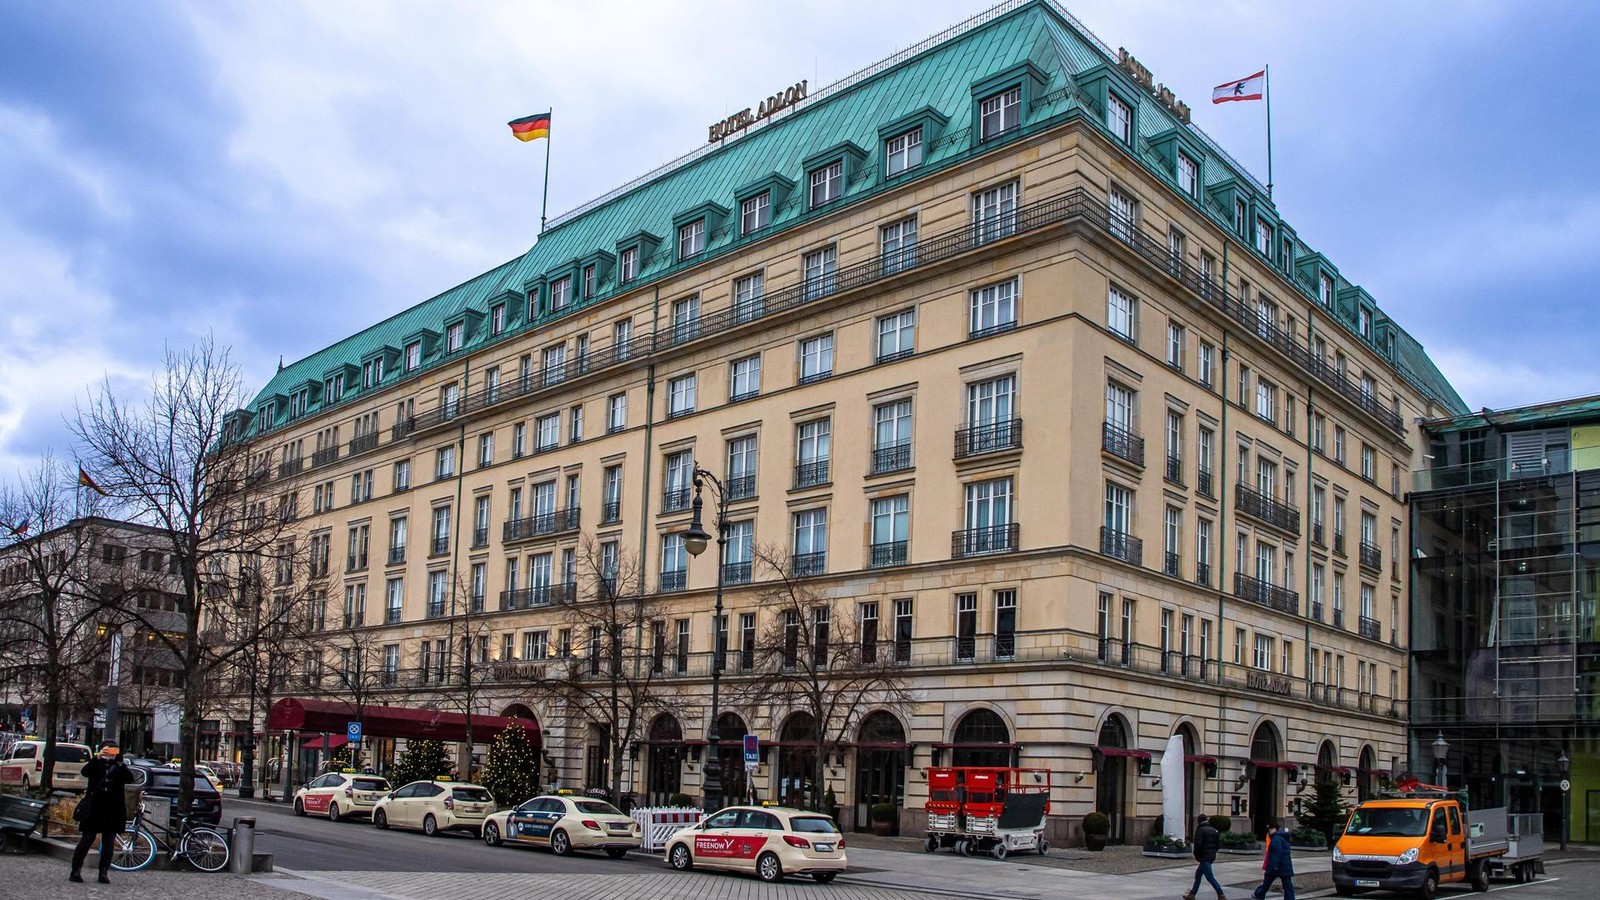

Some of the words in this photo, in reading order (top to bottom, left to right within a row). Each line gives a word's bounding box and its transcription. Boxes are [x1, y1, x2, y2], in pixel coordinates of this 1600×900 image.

[708, 107, 754, 142] HOTEL
[756, 79, 808, 120] ADLON
[696, 842, 725, 850] FREENOW
